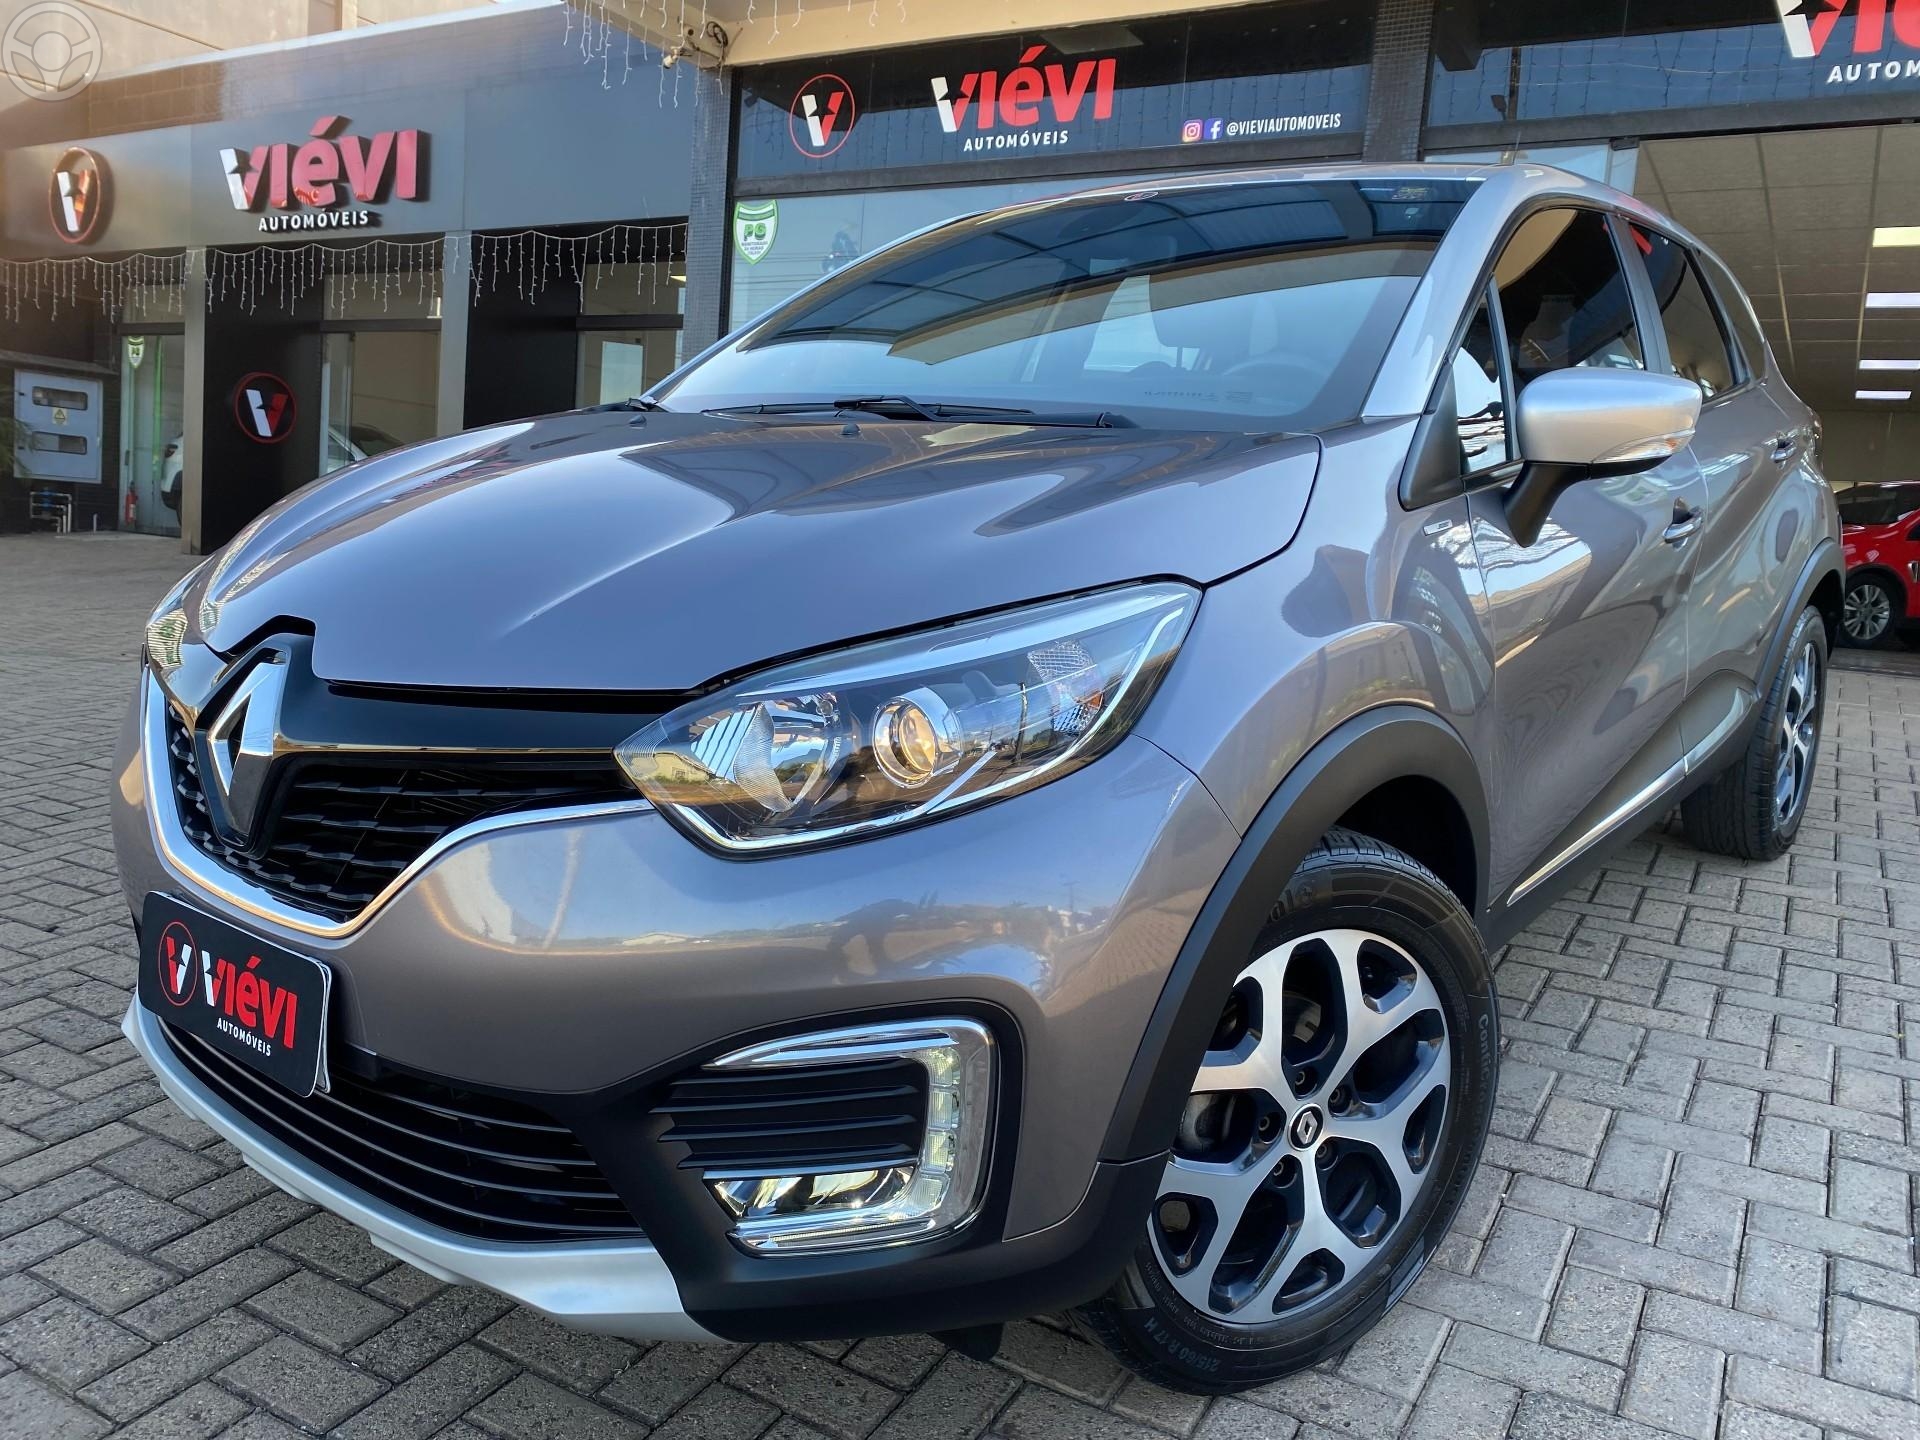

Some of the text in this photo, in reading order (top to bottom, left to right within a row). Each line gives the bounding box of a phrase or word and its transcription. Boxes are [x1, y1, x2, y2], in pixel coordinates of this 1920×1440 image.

[1226, 113, 1342, 136] @VIEVIAUTOMOVEIS
[963, 129, 1069, 152] AUTOMÓVEIS
[258, 207, 369, 232] AUTOMÓVEIS
[216, 1017, 272, 1057] AUTOMÓVEIS
